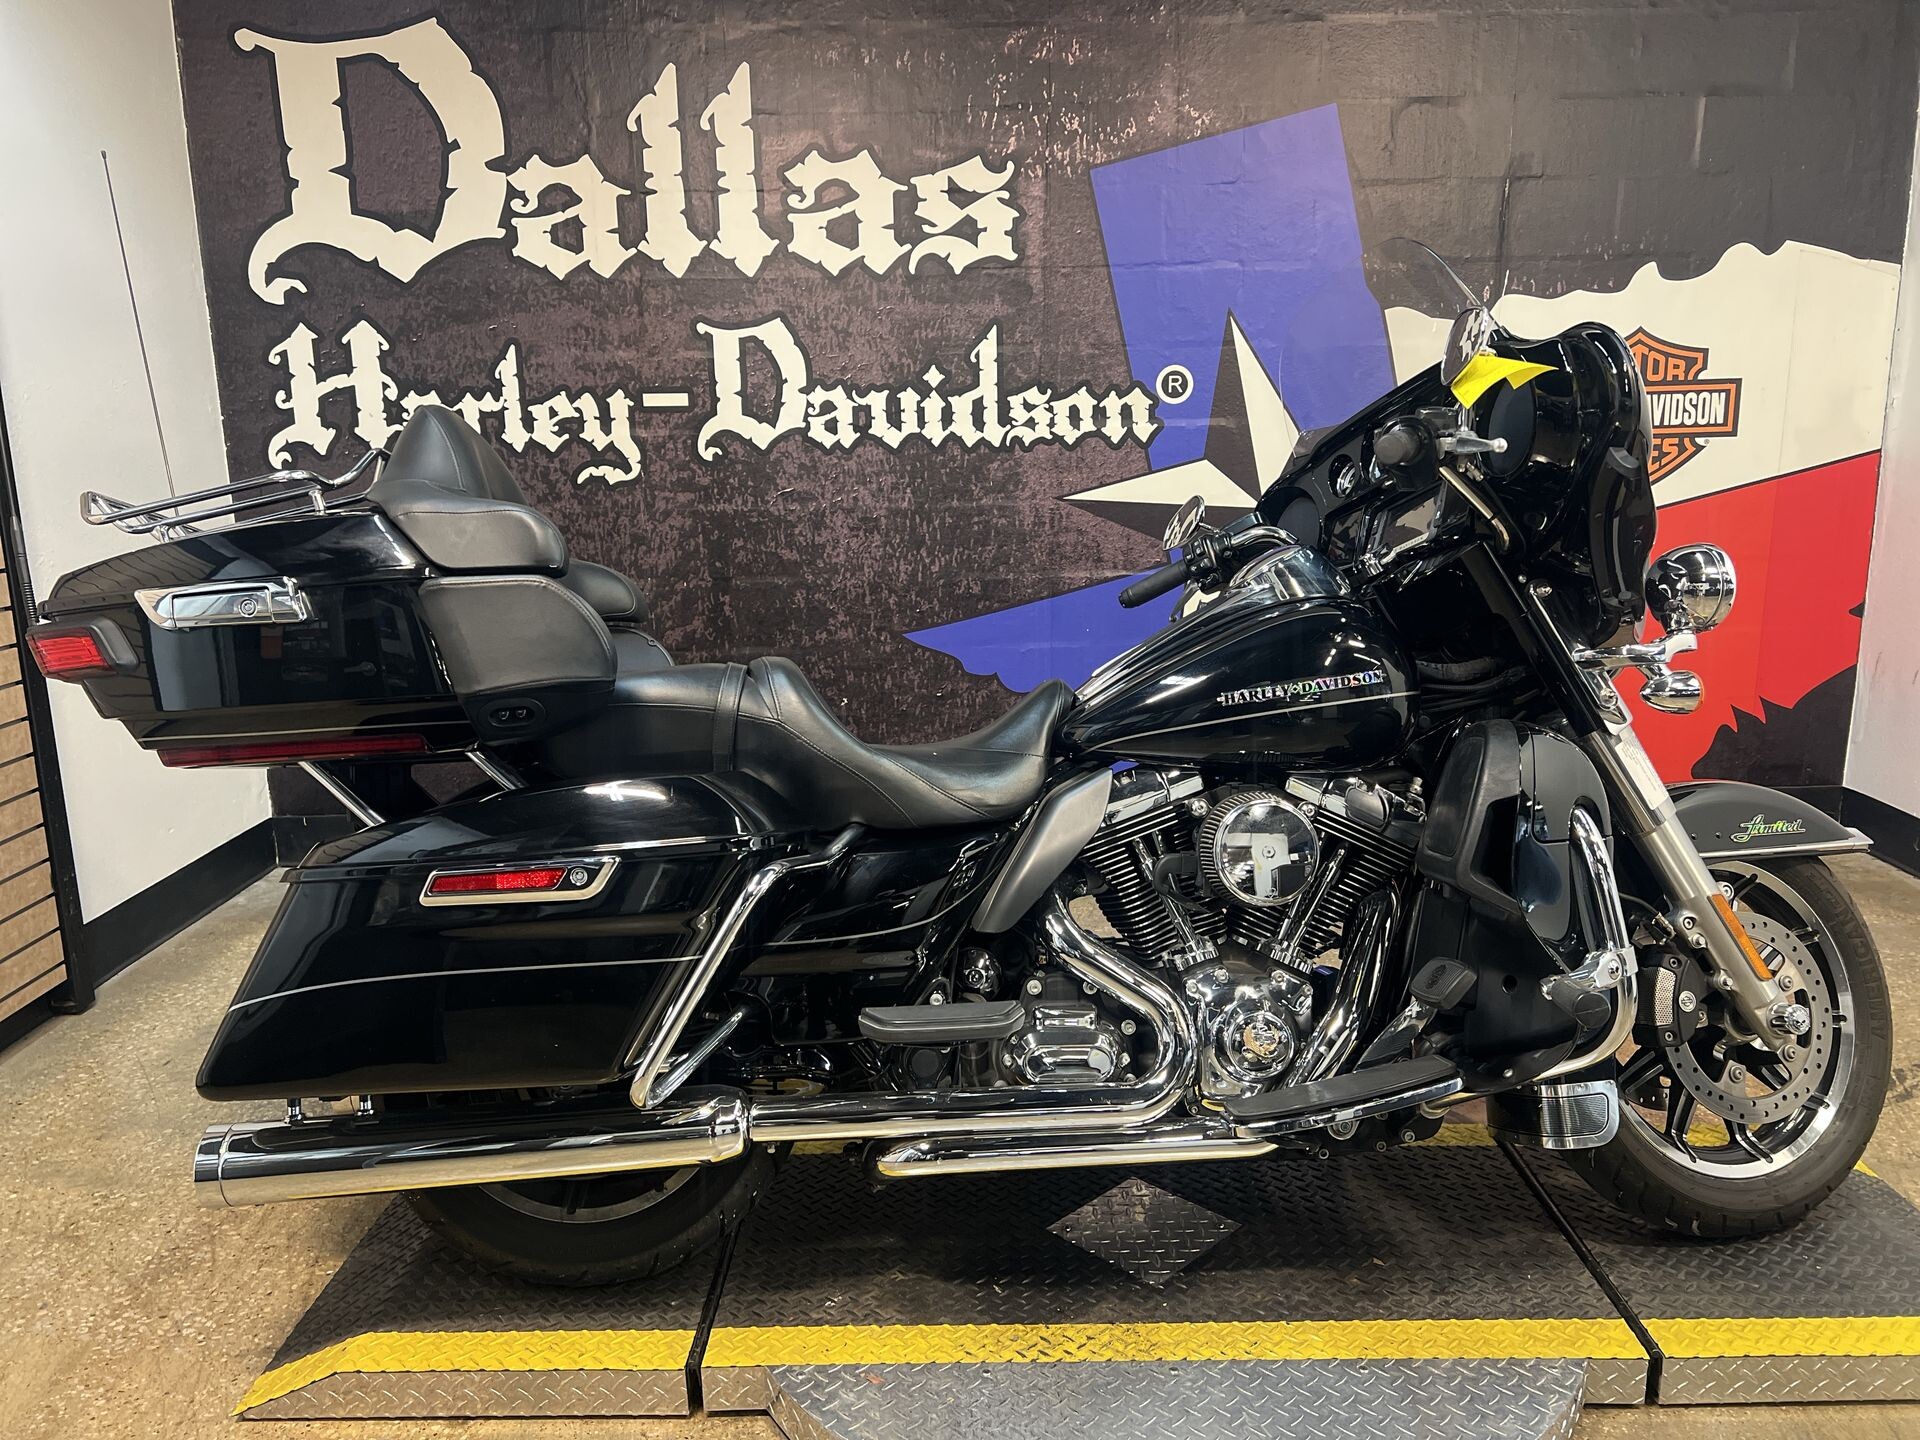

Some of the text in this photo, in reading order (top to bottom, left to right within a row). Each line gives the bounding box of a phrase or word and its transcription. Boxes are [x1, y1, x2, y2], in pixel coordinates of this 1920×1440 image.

[233, 17, 1020, 305] Dallas
[1632, 343, 1686, 382] TOR
[1648, 391, 1727, 426] VIDSON
[1730, 814, 1806, 843] Limited
